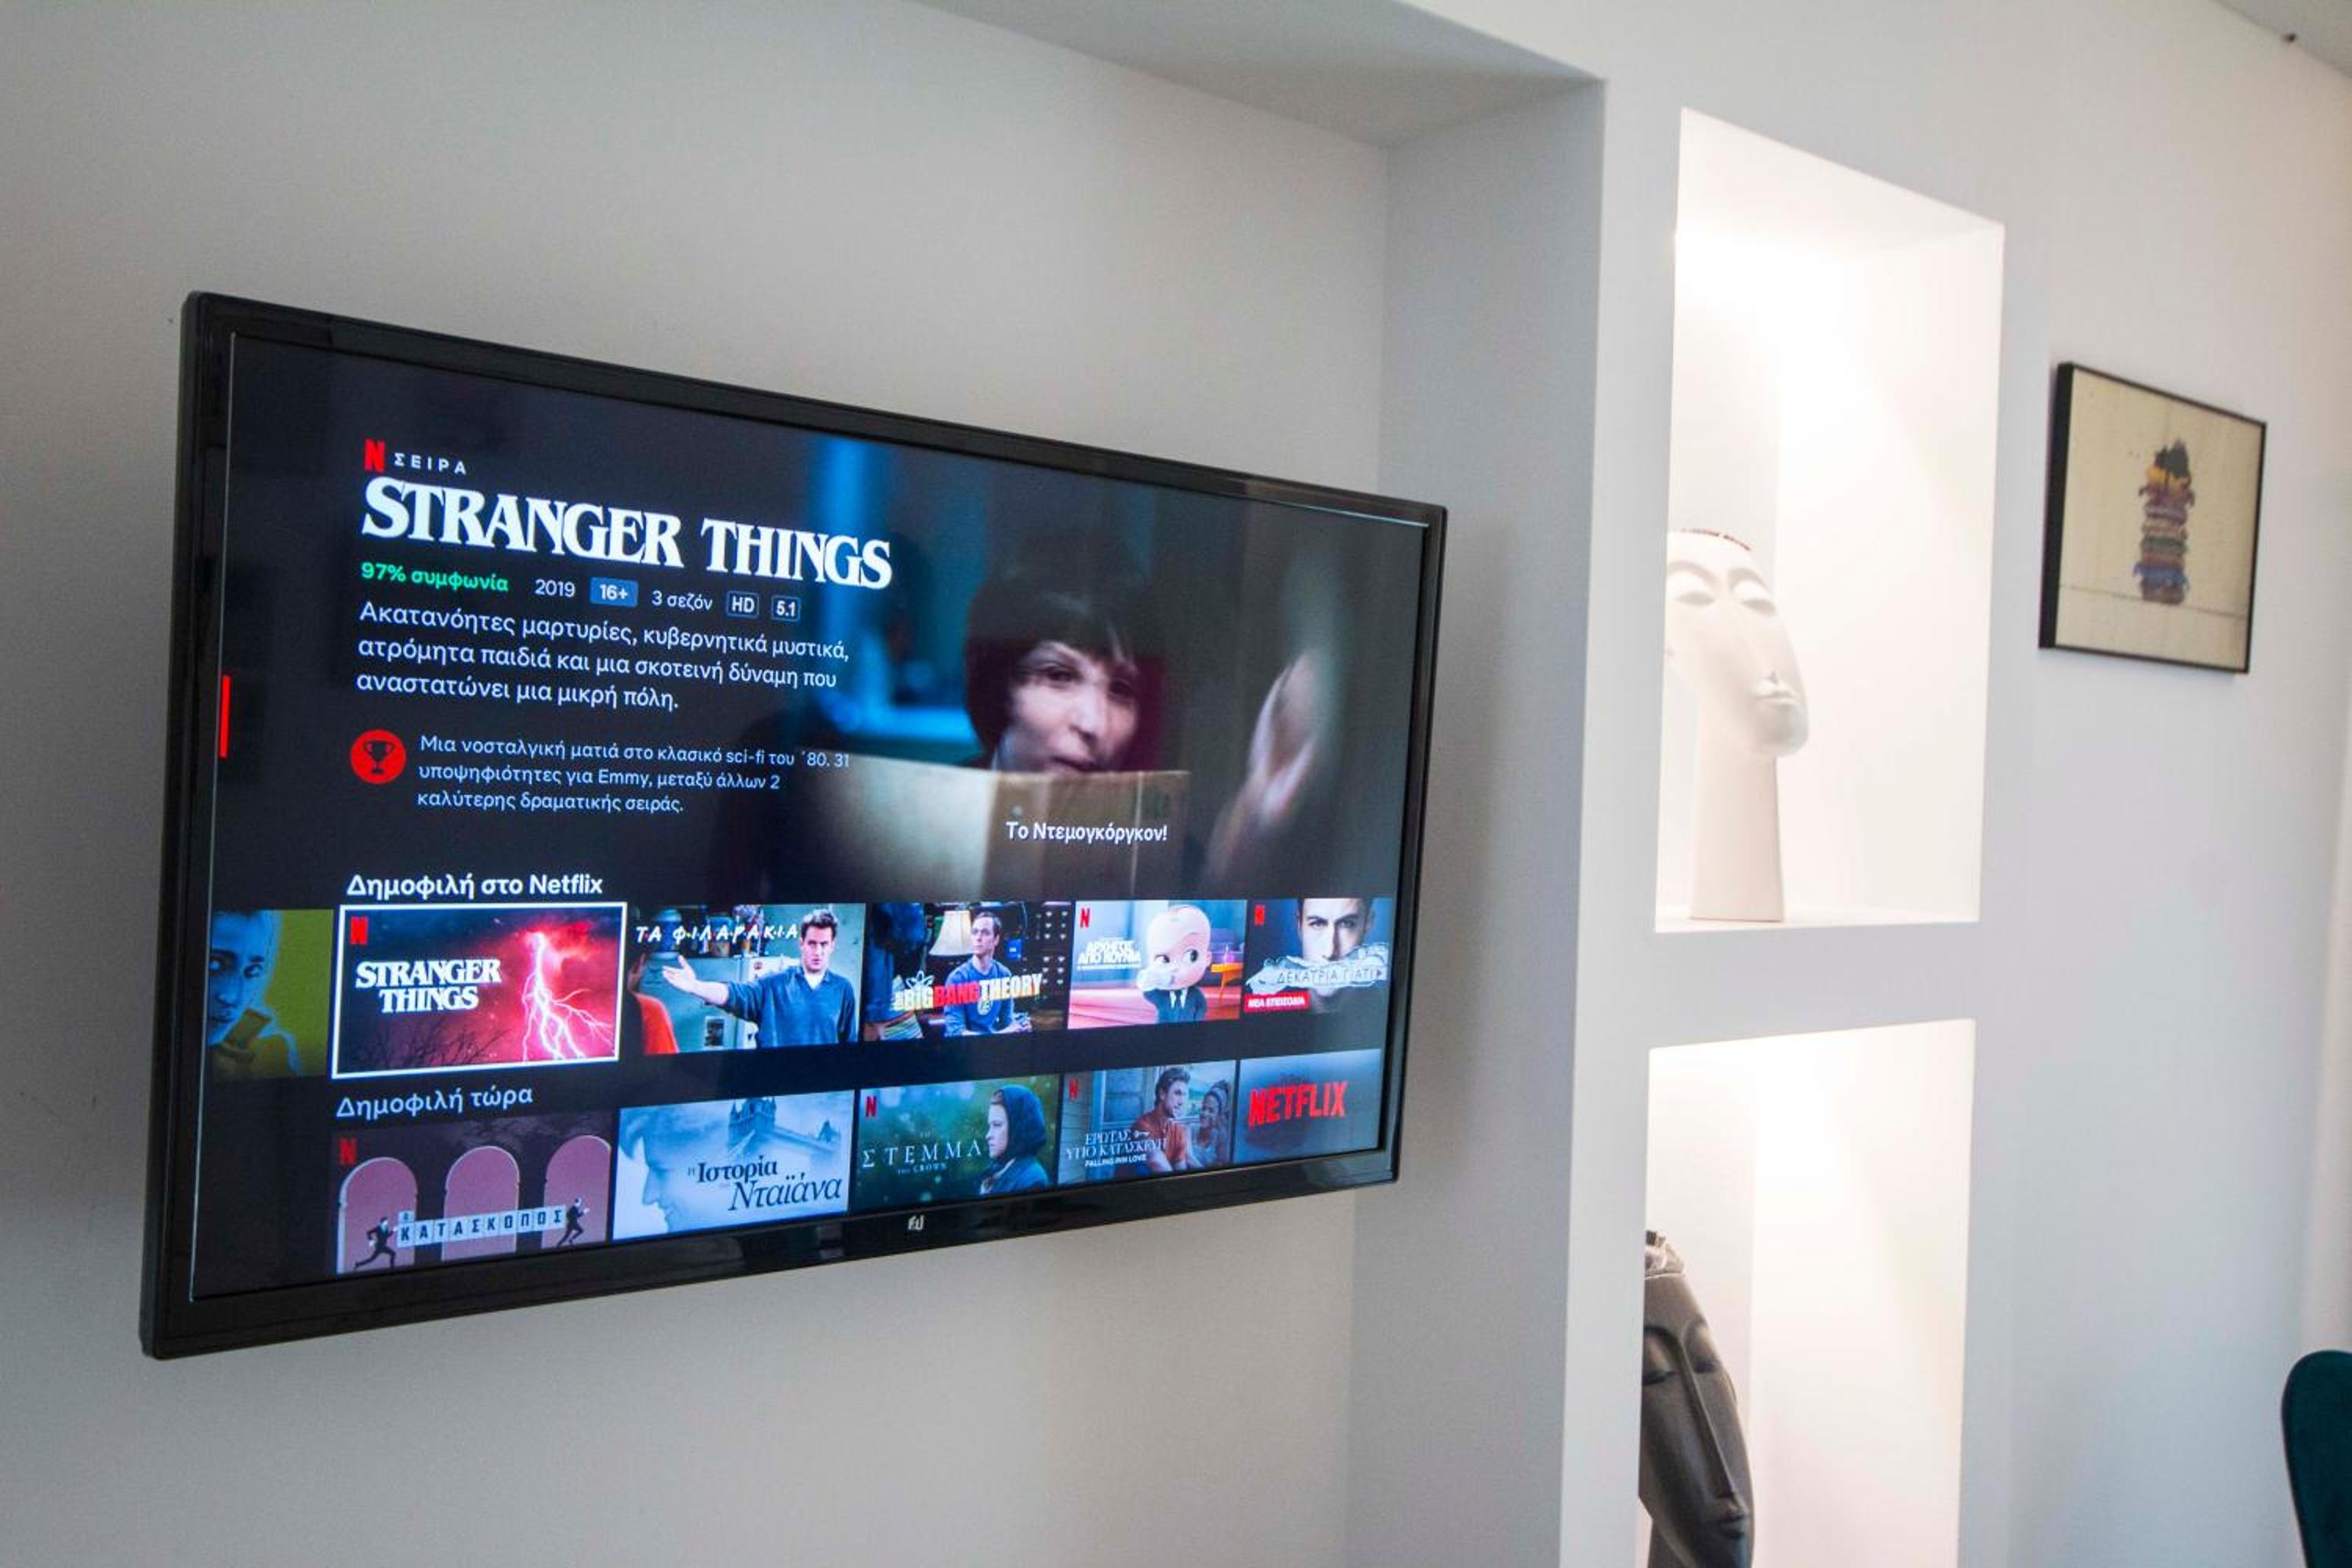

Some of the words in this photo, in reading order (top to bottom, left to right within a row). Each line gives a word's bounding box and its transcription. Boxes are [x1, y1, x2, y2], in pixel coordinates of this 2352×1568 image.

[394, 452, 466, 474] ΣΕΙΡΑ
[361, 477, 684, 568] STRANGER
[700, 518, 892, 590] THINGS
[361, 562, 406, 583] 97%
[412, 571, 509, 592] συμφωνία
[535, 579, 575, 597] 2019
[600, 584, 628, 601] 16+
[652, 590, 662, 606] 3
[667, 593, 713, 611] σεζόν
[731, 597, 755, 613] HD
[776, 601, 796, 617] 5.1
[359, 601, 515, 635] Ακατανόητες
[521, 618, 637, 646] μαρτυρίες,
[644, 627, 767, 654] κυβερνητικά
[772, 640, 849, 662] μυστικά,
[358, 638, 474, 665] ατρόμητα
[481, 647, 551, 670] παιδιά
[557, 654, 590, 670] και
[597, 657, 630, 676] μια
[635, 660, 723, 684] σκοτεινή
[728, 663, 797, 689] δύναμη
[804, 673, 837, 688] που
[357, 674, 510, 699] αναστατώνει
[517, 684, 552, 703] μια
[558, 685, 617, 708] μικρή
[624, 687, 678, 712] πόλη.
[420, 735, 456, 753] Μια
[461, 739, 565, 760] νοσταλγική
[571, 742, 619, 760] ματιά
[623, 747, 653, 760] στο
[657, 746, 722, 764] κλασικό
[726, 749, 765, 764] sci-fi
[768, 753, 794, 766] του
[834, 753, 850, 768] 31
[419, 765, 561, 784] υποψηφιότητες
[566, 771, 593, 786] για
[598, 768, 653, 787] Emmy,
[657, 772, 712, 789] μεταξύ
[717, 773, 766, 789] άλλων
[770, 775, 780, 789] 2
[417, 790, 516, 811] καλύτερης
[520, 792, 621, 813] δραματικής
[625, 795, 684, 813] σειράς.
[1006, 821, 1029, 840] Το
[1033, 822, 1167, 844] Ντεμογκόργκον!
[347, 873, 474, 900] Δημοφιλή
[481, 879, 523, 895] στο
[529, 875, 602, 895] Netflix
[355, 959, 502, 989] STRANGER
[978, 973, 1044, 1001] THEORY
[379, 986, 479, 1014] THINGS
[336, 1087, 463, 1120] Δημοφιλή
[470, 1085, 534, 1110] τώρα
[1249, 1081, 1348, 1129] NETFLIX
[862, 1139, 981, 1167] ΣΤΕΜΜΑ
[697, 1156, 779, 1184] Ιστορία
[728, 1173, 842, 1211] Νταϊάνα
[401, 1210, 562, 1242] ΚΑΤΑΣΚΟΠΟΣ
